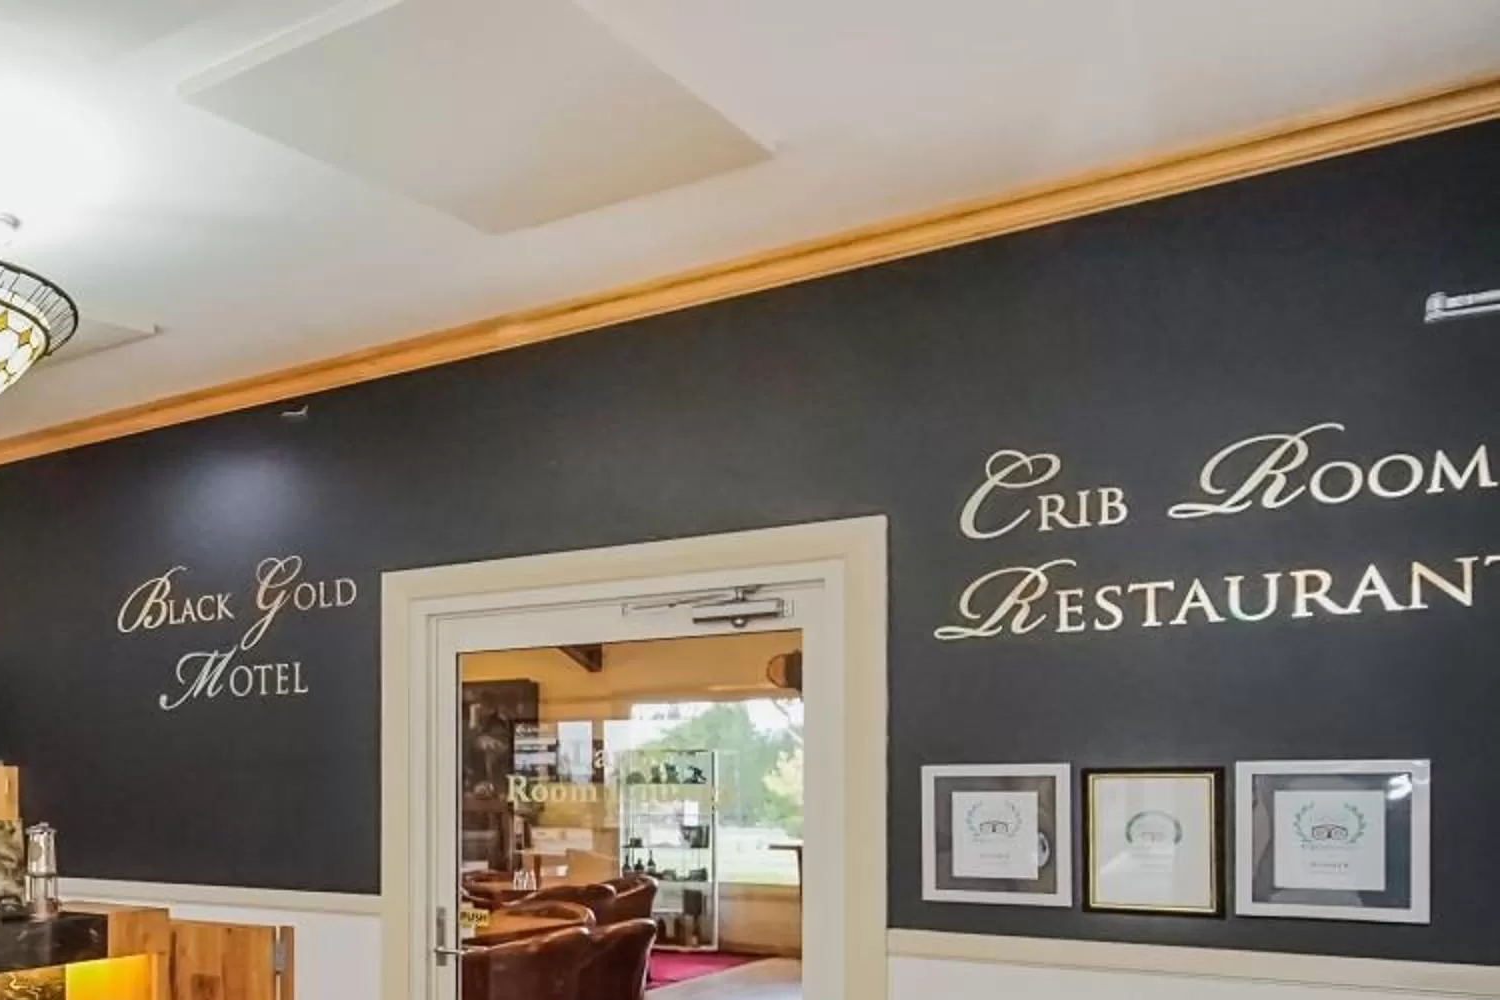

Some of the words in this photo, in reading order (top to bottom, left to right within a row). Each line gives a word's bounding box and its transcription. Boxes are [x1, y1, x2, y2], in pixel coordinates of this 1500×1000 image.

[959, 449, 1129, 540] CRIB
[1166, 422, 1499, 519] ROOM
[117, 565, 236, 633] BLACK
[240, 555, 357, 651] GOLD
[159, 644, 309, 711] MOTEL
